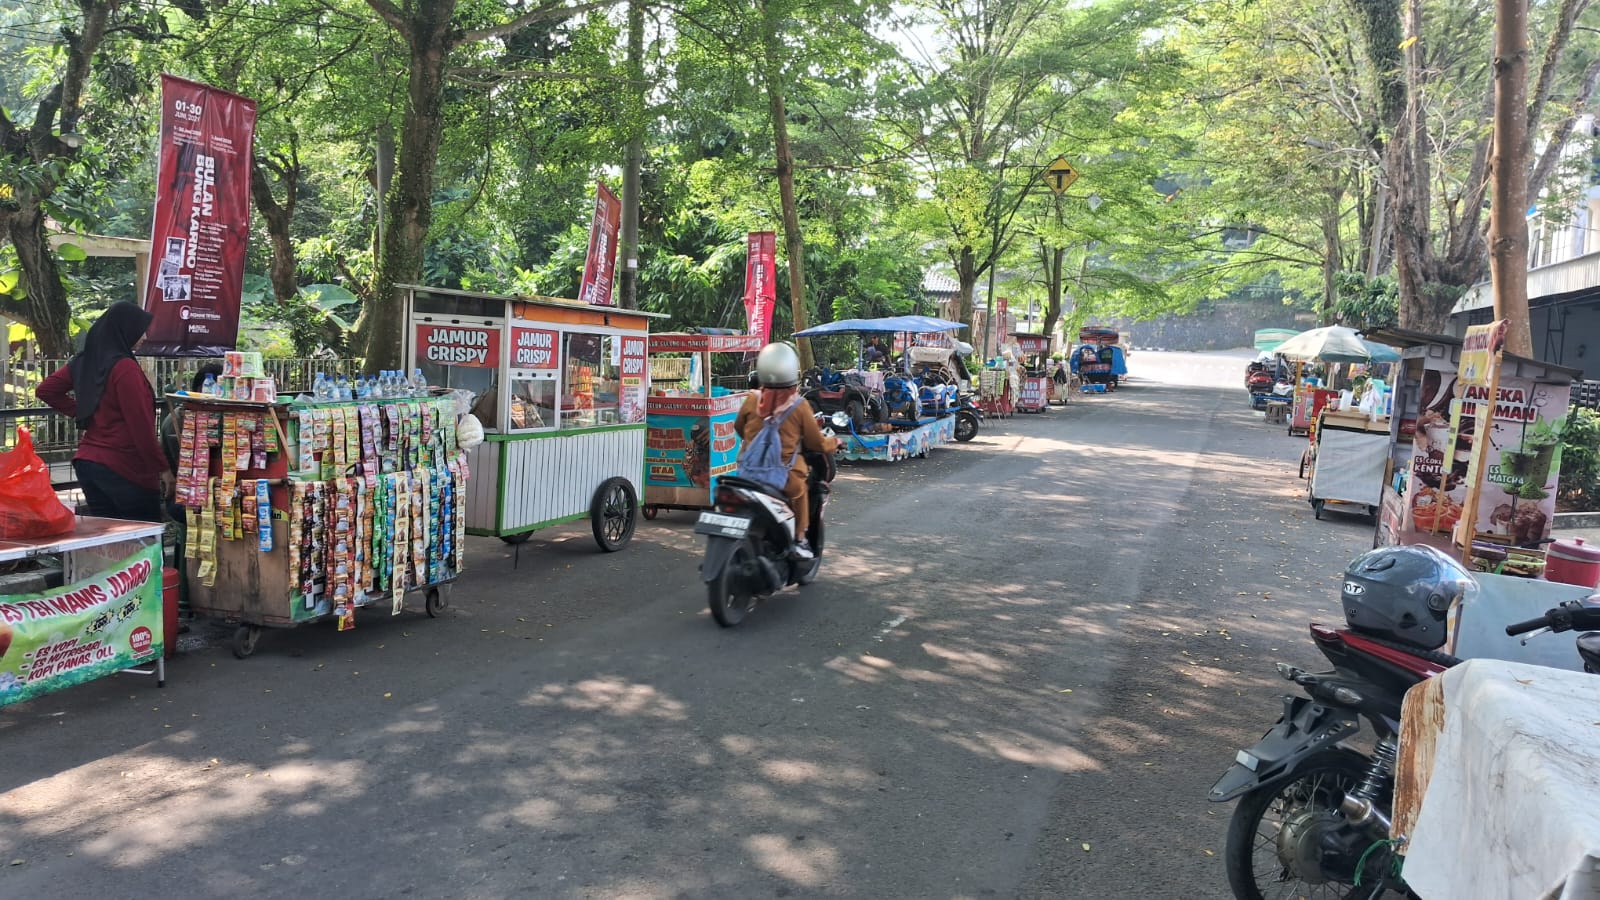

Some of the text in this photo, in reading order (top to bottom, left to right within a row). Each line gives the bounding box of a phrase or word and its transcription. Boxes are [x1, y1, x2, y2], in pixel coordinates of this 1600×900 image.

[175, 100, 202, 115] 01-30
[202, 157, 214, 216] BULAN
[187, 154, 205, 269] BUNG KARNO
[427, 329, 488, 347] JAMUR
[517, 332, 552, 348] JAMUR
[427, 346, 488, 364] CRISPY
[516, 349, 552, 364] CRISPY
[623, 340, 644, 356] JAMUR
[623, 357, 644, 374] CRISPY
[1466, 386, 1524, 404] ANEKA
[1488, 474, 1525, 484] MATCHA
[1489, 466, 1500, 475] ES
[0, 603, 23, 622] ES
[16, 600, 56, 619] TEH
[48, 584, 108, 615] MANIS
[107, 560, 152, 599] JUMBO
[131, 631, 150, 642] 100%
[32, 658, 47, 669] ES
[48, 640, 102, 664] NUTRISARI
[36, 646, 51, 658] ES
[52, 638, 78, 653] KOPI
[28, 664, 54, 680] KOPI
[96, 646, 113, 659] OLL
